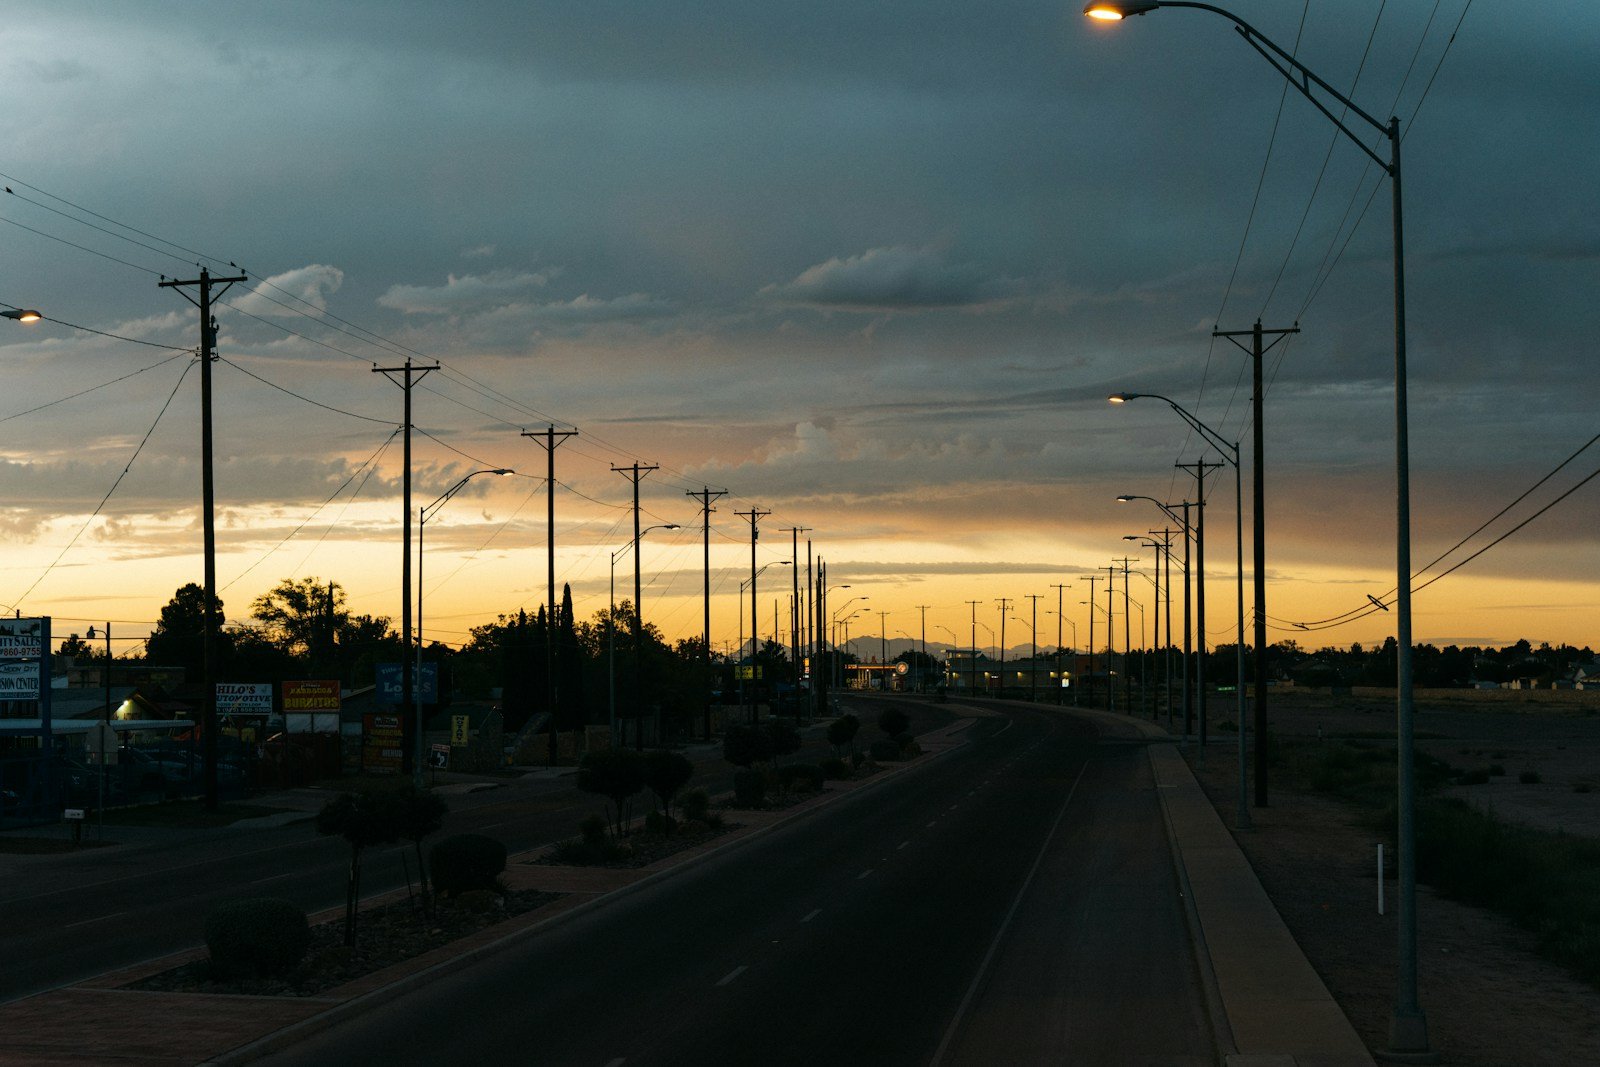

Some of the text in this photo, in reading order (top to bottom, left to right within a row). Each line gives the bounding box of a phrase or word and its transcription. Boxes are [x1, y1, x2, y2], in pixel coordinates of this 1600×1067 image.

[14, 636, 41, 647] SALES
[16, 677, 39, 690] CENTER
[218, 685, 256, 694] HILO'S
